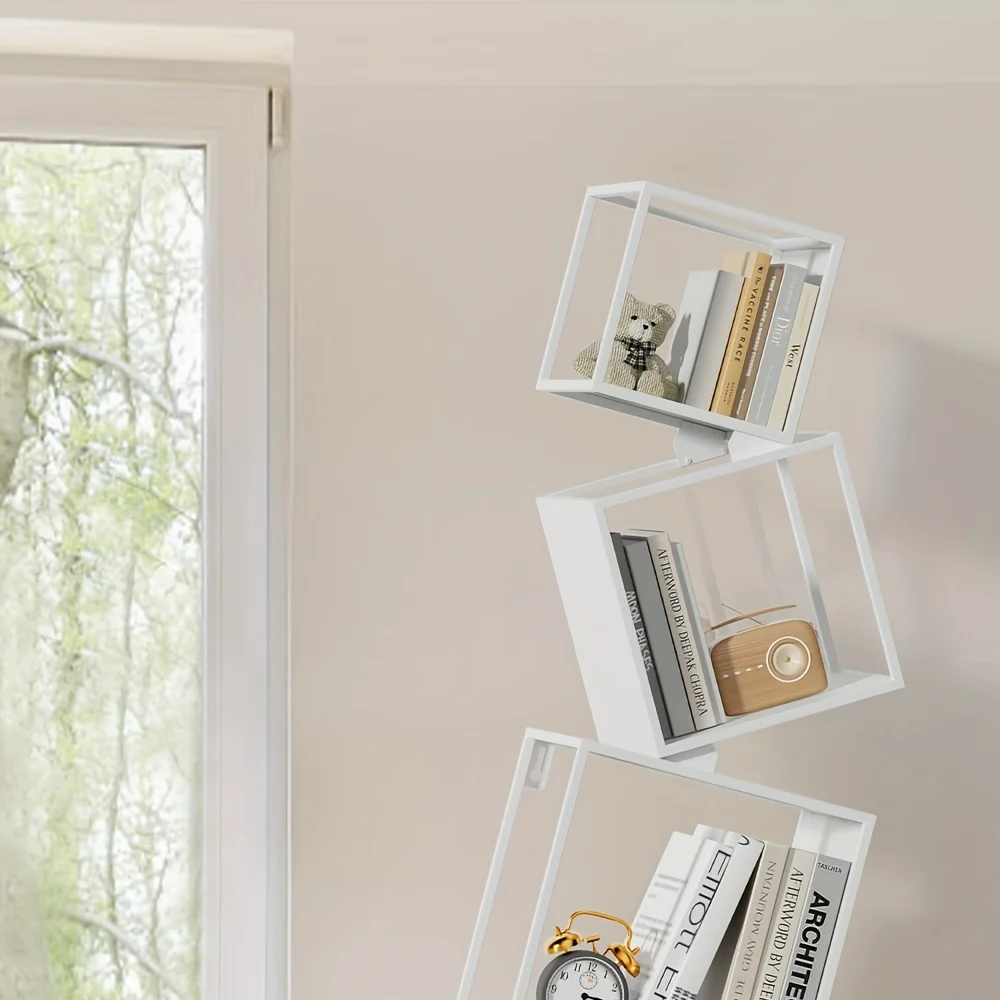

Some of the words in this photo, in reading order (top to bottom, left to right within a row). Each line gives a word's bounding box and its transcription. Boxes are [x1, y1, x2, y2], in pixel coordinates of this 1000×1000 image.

[742, 288, 759, 332] VACCINE
[772, 316, 790, 347] Dior
[734, 336, 746, 362] RACE
[786, 344, 801, 368] West
[656, 548, 682, 613] AFTERWORD
[674, 615, 686, 629] BY
[678, 631, 697, 672] DEEPAK
[689, 673, 708, 717] CHOPRA
[816, 861, 842, 873] TASCHEN
[773, 866, 804, 950] AFTERWORD
[734, 980, 746, 996] DE
[741, 936, 757, 972] GRAY
[751, 860, 777, 935] MOUNTAIN
[574, 963, 582, 972] 11
[588, 962, 598, 972] 12
[768, 953, 783, 972] BY
[560, 971, 569, 980] 10
[604, 970, 608, 979] 1
[550, 984, 557, 993] 9
[611, 983, 618, 993] 2
